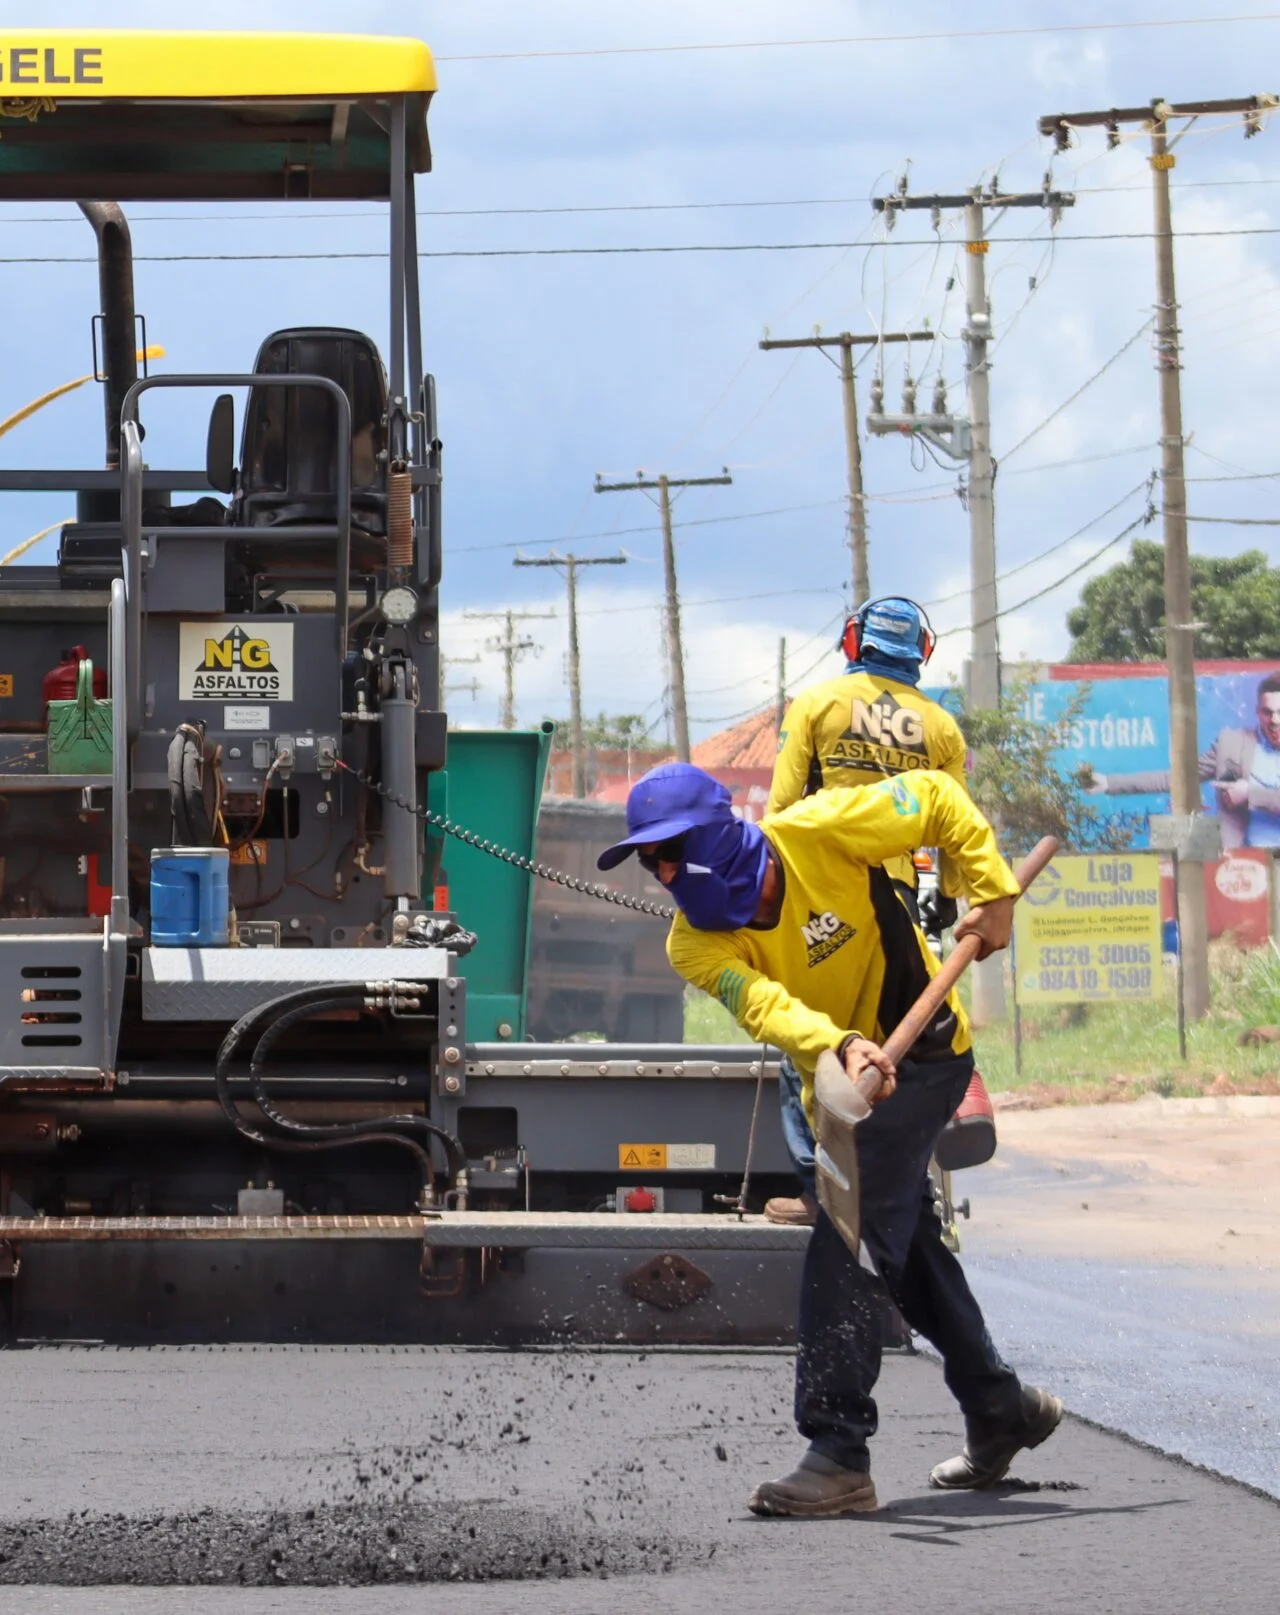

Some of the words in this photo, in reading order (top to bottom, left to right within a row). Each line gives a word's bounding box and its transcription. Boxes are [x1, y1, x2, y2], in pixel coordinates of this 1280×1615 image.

[204, 639, 271, 669] NG
[193, 675, 280, 689] ASFALTOS
[833, 739, 931, 770] ASFALTOS
[1088, 858, 1133, 885] Loja
[1065, 887, 1157, 908] Gonçalves
[808, 923, 853, 960] ASFALTOS
